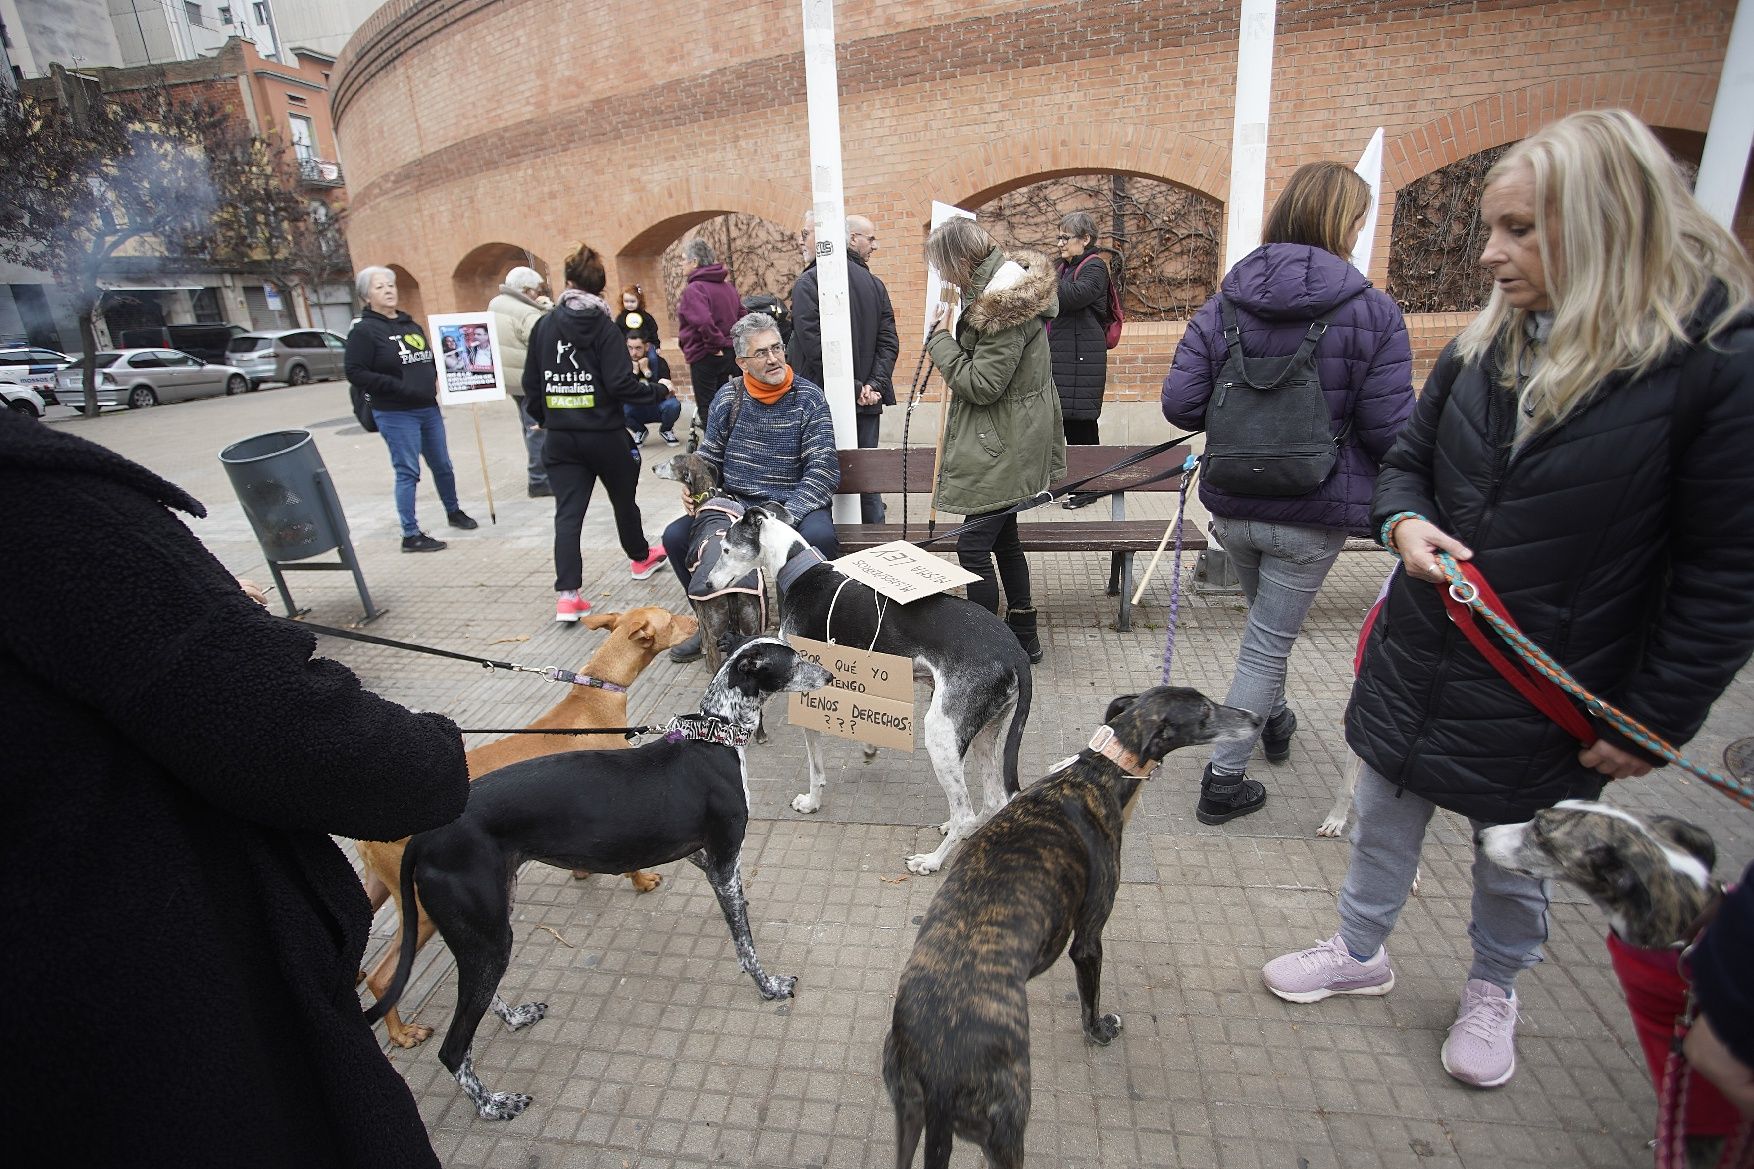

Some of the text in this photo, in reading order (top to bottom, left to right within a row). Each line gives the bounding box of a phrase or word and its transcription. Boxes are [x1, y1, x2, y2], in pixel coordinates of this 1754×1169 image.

[544, 370, 592, 382] Partido
[545, 382, 595, 394] Animalista
[551, 395, 589, 407] PACMA
[869, 549, 917, 567] LEY
[835, 659, 857, 675] QUÉ
[871, 667, 889, 682] YO
[800, 690, 839, 712] MENOS
